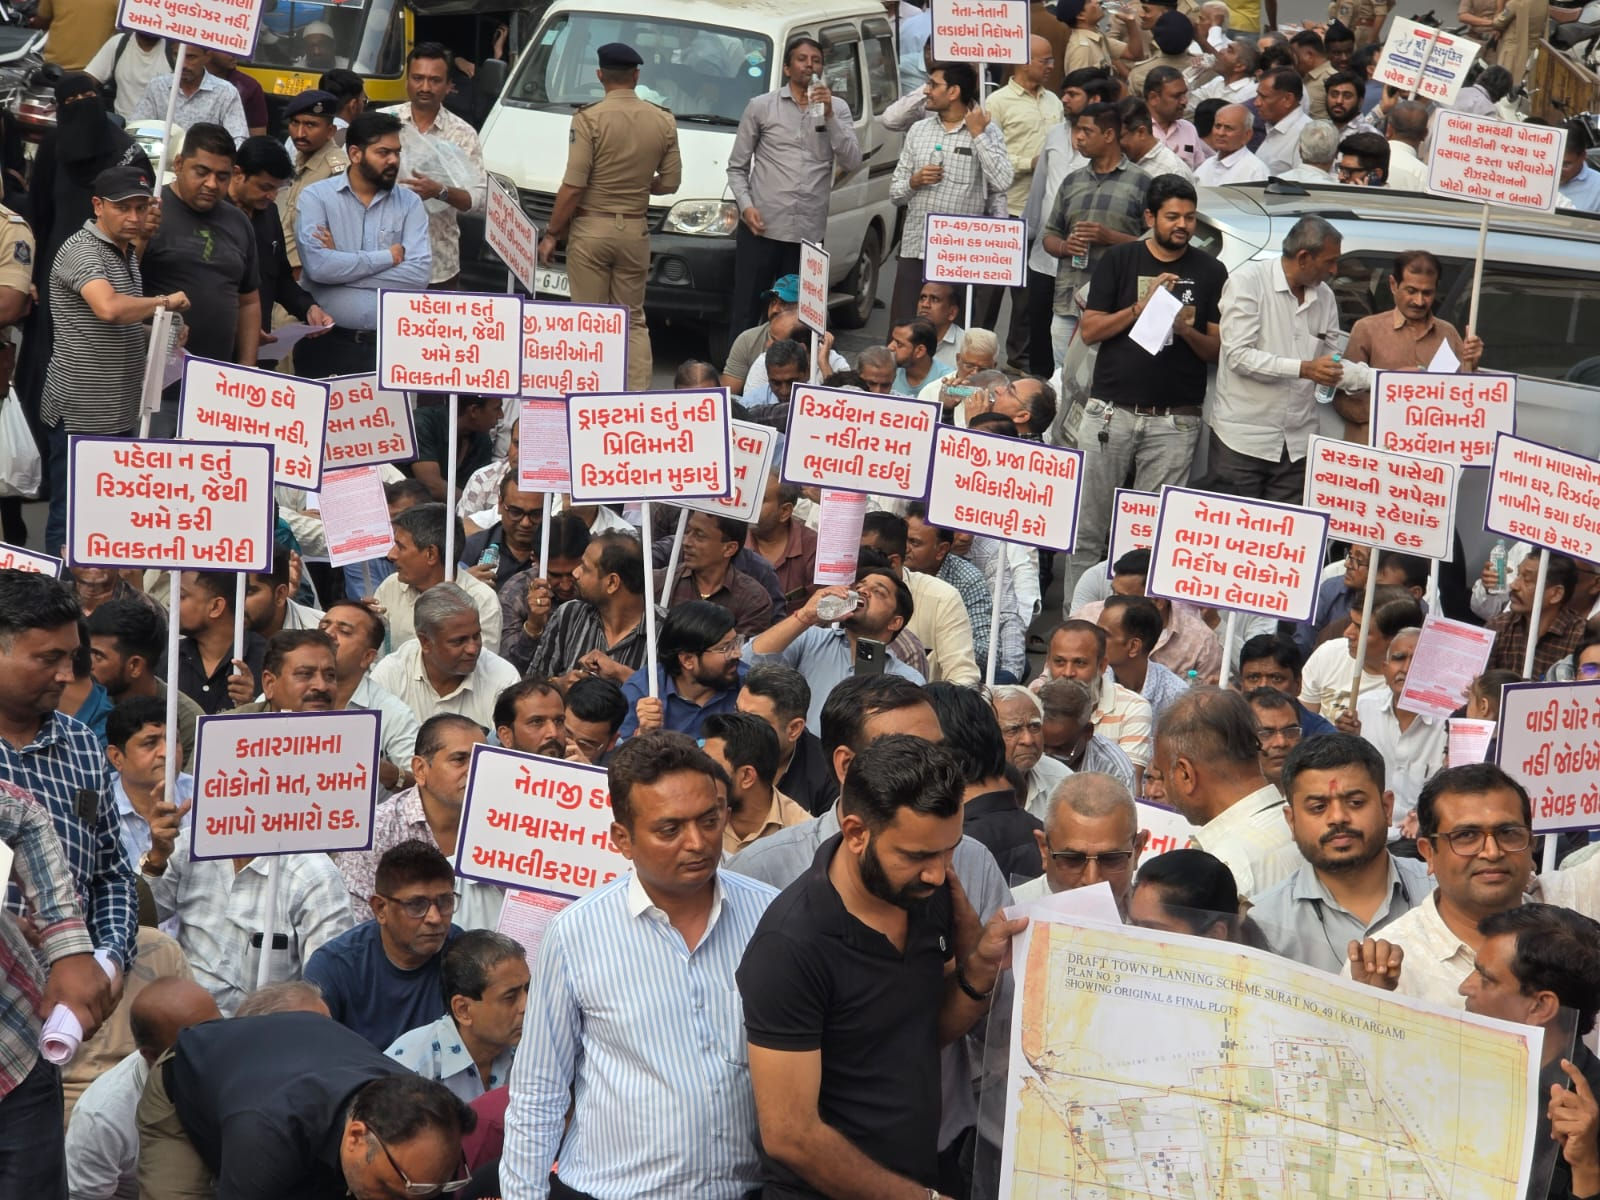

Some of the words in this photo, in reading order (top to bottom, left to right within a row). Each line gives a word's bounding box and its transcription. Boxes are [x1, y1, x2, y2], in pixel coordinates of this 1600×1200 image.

[410, 295, 451, 314] પહેલા
[456, 302, 467, 315] ન
[470, 302, 494, 324] હતું
[545, 316, 574, 332] પ્રજા
[577, 310, 622, 334] વિરોધી
[398, 316, 467, 342] રિઝર્વેશન,
[472, 320, 505, 341] જેથી
[422, 344, 451, 362] અમે
[455, 344, 480, 364] કરી
[524, 338, 603, 362] ધિકારીઓની
[216, 373, 266, 408] નેતાજી
[272, 386, 296, 408] હવે
[390, 364, 461, 386] મિલકતની
[466, 368, 510, 389] ખરીદી
[522, 369, 573, 395] કાલપટ્ટી
[576, 371, 600, 392] કરો
[1449, 384, 1474, 408] હતું
[1478, 381, 1508, 403] નહી
[197, 408, 270, 437] આશ્વાસન
[274, 420, 308, 448] નહી,
[650, 402, 679, 431] હતું
[682, 398, 716, 423] નહી
[800, 394, 875, 424] રિઝર્વેશન
[880, 411, 928, 432] હટાવો
[1405, 405, 1486, 428] પ્રિલિમનરી
[603, 429, 694, 455] પ્રિલિમનરી
[825, 426, 880, 452] નહીંતર
[884, 438, 912, 456] મત
[1384, 432, 1456, 454] રિઝર્વેશન
[1460, 440, 1492, 462] મુકા
[114, 444, 172, 468] પહેલા
[179, 453, 194, 470] ન
[200, 449, 232, 480] હતું
[285, 456, 312, 479] કરો
[804, 454, 864, 478] ભૂલાવી
[868, 460, 911, 490] દઈશું
[940, 435, 991, 468] મોદીજી,
[996, 451, 1025, 470] પ્રજા
[1028, 450, 1076, 480] વિરોધી
[1321, 448, 1379, 472] સરકાર
[1388, 462, 1444, 484] પાસેથી
[1513, 450, 1543, 468] નાના
[96, 472, 194, 503] રિઝર્વેશન,
[202, 477, 248, 502] જેથી
[581, 462, 662, 486] રિઝર્વેશન
[668, 462, 720, 492] મુકાયું
[954, 470, 1054, 507] અધિકારીઓની
[1315, 472, 1380, 495] ન્યાયની
[1389, 485, 1446, 508] અપેક્ષા
[1499, 470, 1528, 488] નાના
[1531, 478, 1554, 496] ઘર,
[130, 506, 171, 528] અમે
[178, 506, 212, 531] કરી
[954, 504, 1020, 536] હકાલપટ્ટી
[1022, 514, 1046, 536] કરો
[1195, 501, 1231, 525] નેતા
[1236, 508, 1294, 536] નેતાની
[1317, 493, 1366, 517] અમારૂ
[1376, 502, 1440, 528] રહેણાંક
[1498, 494, 1541, 516] નાખીને
[1544, 506, 1570, 524] કયા
[1176, 529, 1220, 548] ભાગ
[1225, 538, 1305, 564] બટાઈમાં
[1330, 518, 1385, 540] અમારો
[1394, 532, 1422, 548] હક
[1509, 520, 1541, 540] કરવા
[1544, 526, 1557, 544] છે
[87, 533, 186, 560] મિલકતની
[192, 537, 254, 563] ખરીદી
[1172, 548, 1227, 576] નિર્દોષ
[1233, 560, 1300, 588] લોકોનો
[1175, 576, 1220, 600] ભોગ
[1225, 584, 1288, 611] લેવાયો
[236, 736, 341, 759] કતારગામના
[204, 768, 270, 798] લોકોનો
[276, 774, 310, 796] મત,
[316, 763, 367, 792] અમને
[515, 766, 582, 810] નેતાજી
[206, 806, 256, 836] આપો
[262, 803, 322, 832] અમારો
[328, 809, 360, 830] હક.
[487, 808, 585, 845] આશ્વાસન
[472, 846, 596, 888] અમલીકરણ
[1067, 967, 1093, 979] PLAN
[1114, 974, 1120, 983] 3
[1068, 953, 1110, 970] DRAFT
[1112, 958, 1150, 976] TOWN
[1152, 966, 1214, 988] PLANNING
[1216, 977, 1262, 997] SCHEME
[1264, 988, 1299, 1007] SURAT
[1322, 1007, 1333, 1018] 49
[1065, 978, 1112, 994] SHOWING
[1114, 986, 1164, 1002] ORIGINAL
[1167, 995, 1172, 1003] &
[1176, 996, 1206, 1010] FINAL
[1209, 1002, 1239, 1016] PLOTS
